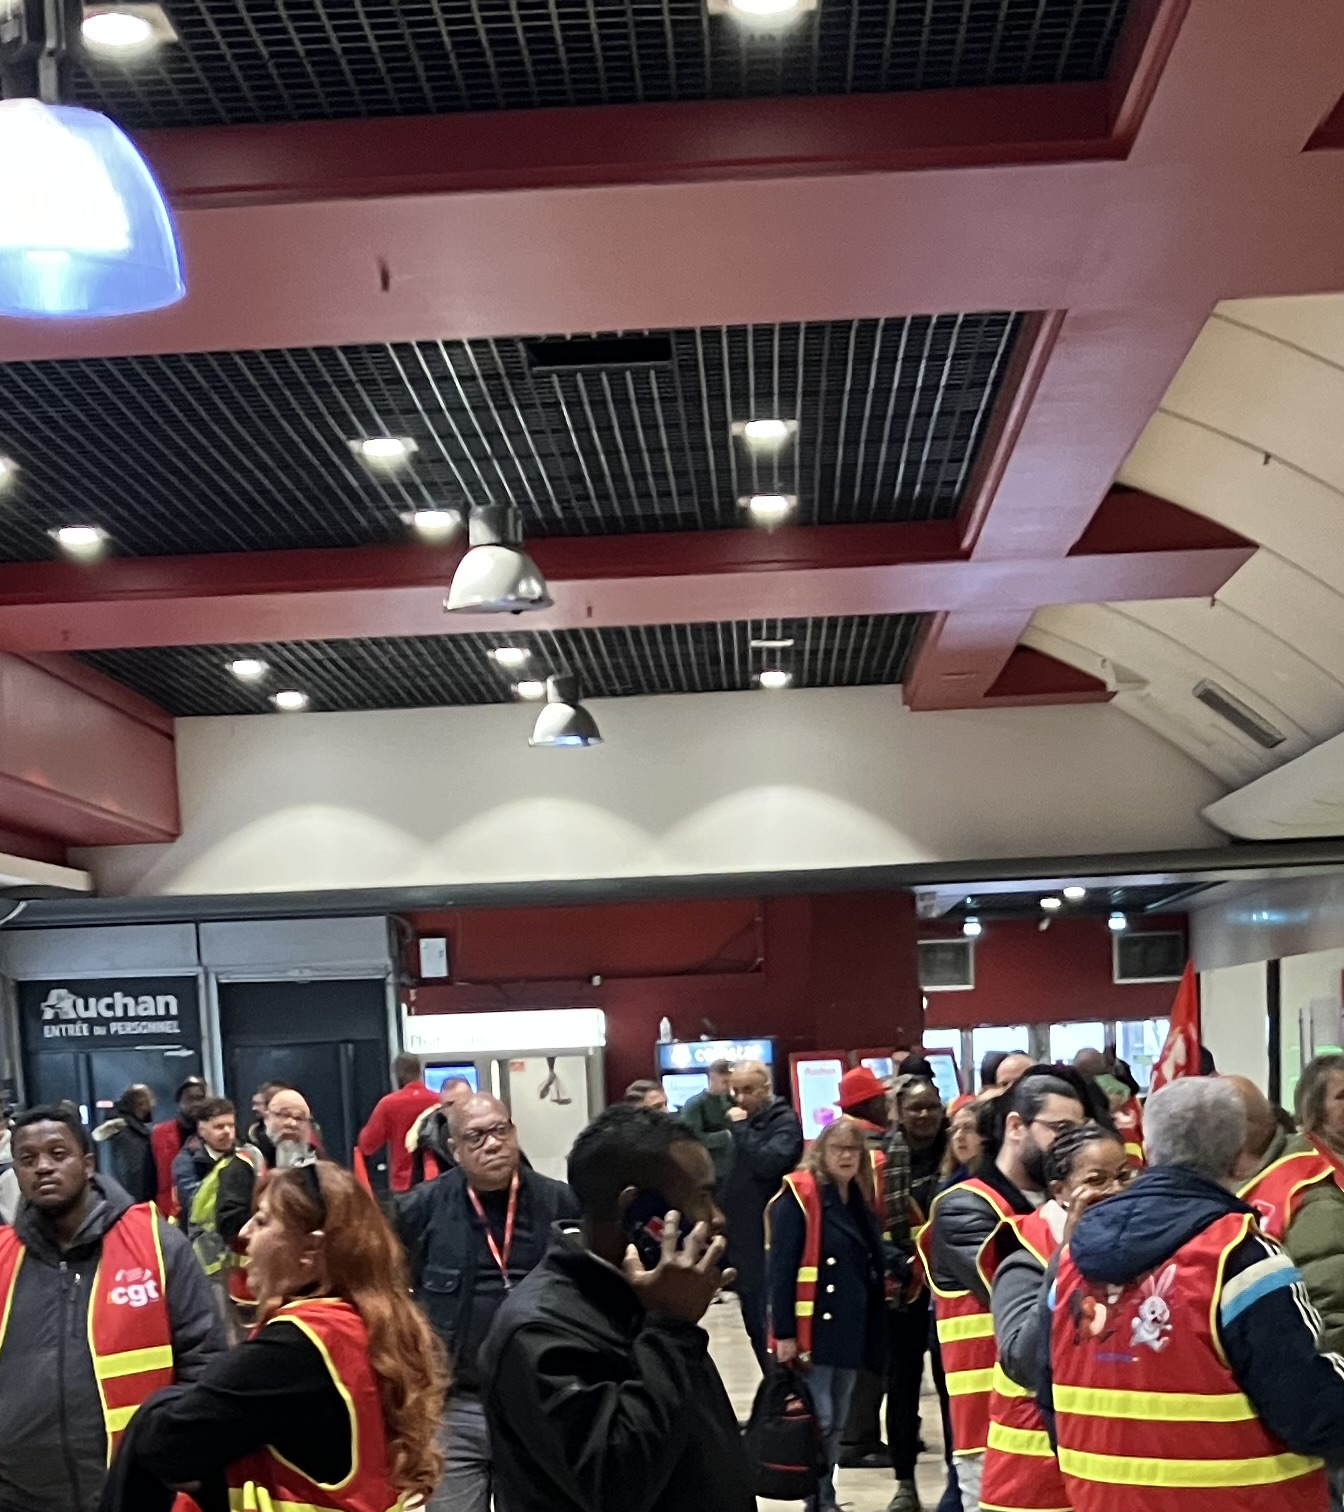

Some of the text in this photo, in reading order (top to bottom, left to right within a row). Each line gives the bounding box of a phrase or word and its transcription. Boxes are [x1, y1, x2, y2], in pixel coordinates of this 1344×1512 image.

[41, 988, 178, 1020] Auchan
[43, 1020, 89, 1038] ENTRÉE
[109, 1020, 181, 1036] PERSONNEL
[111, 1279, 159, 1308] cgt
